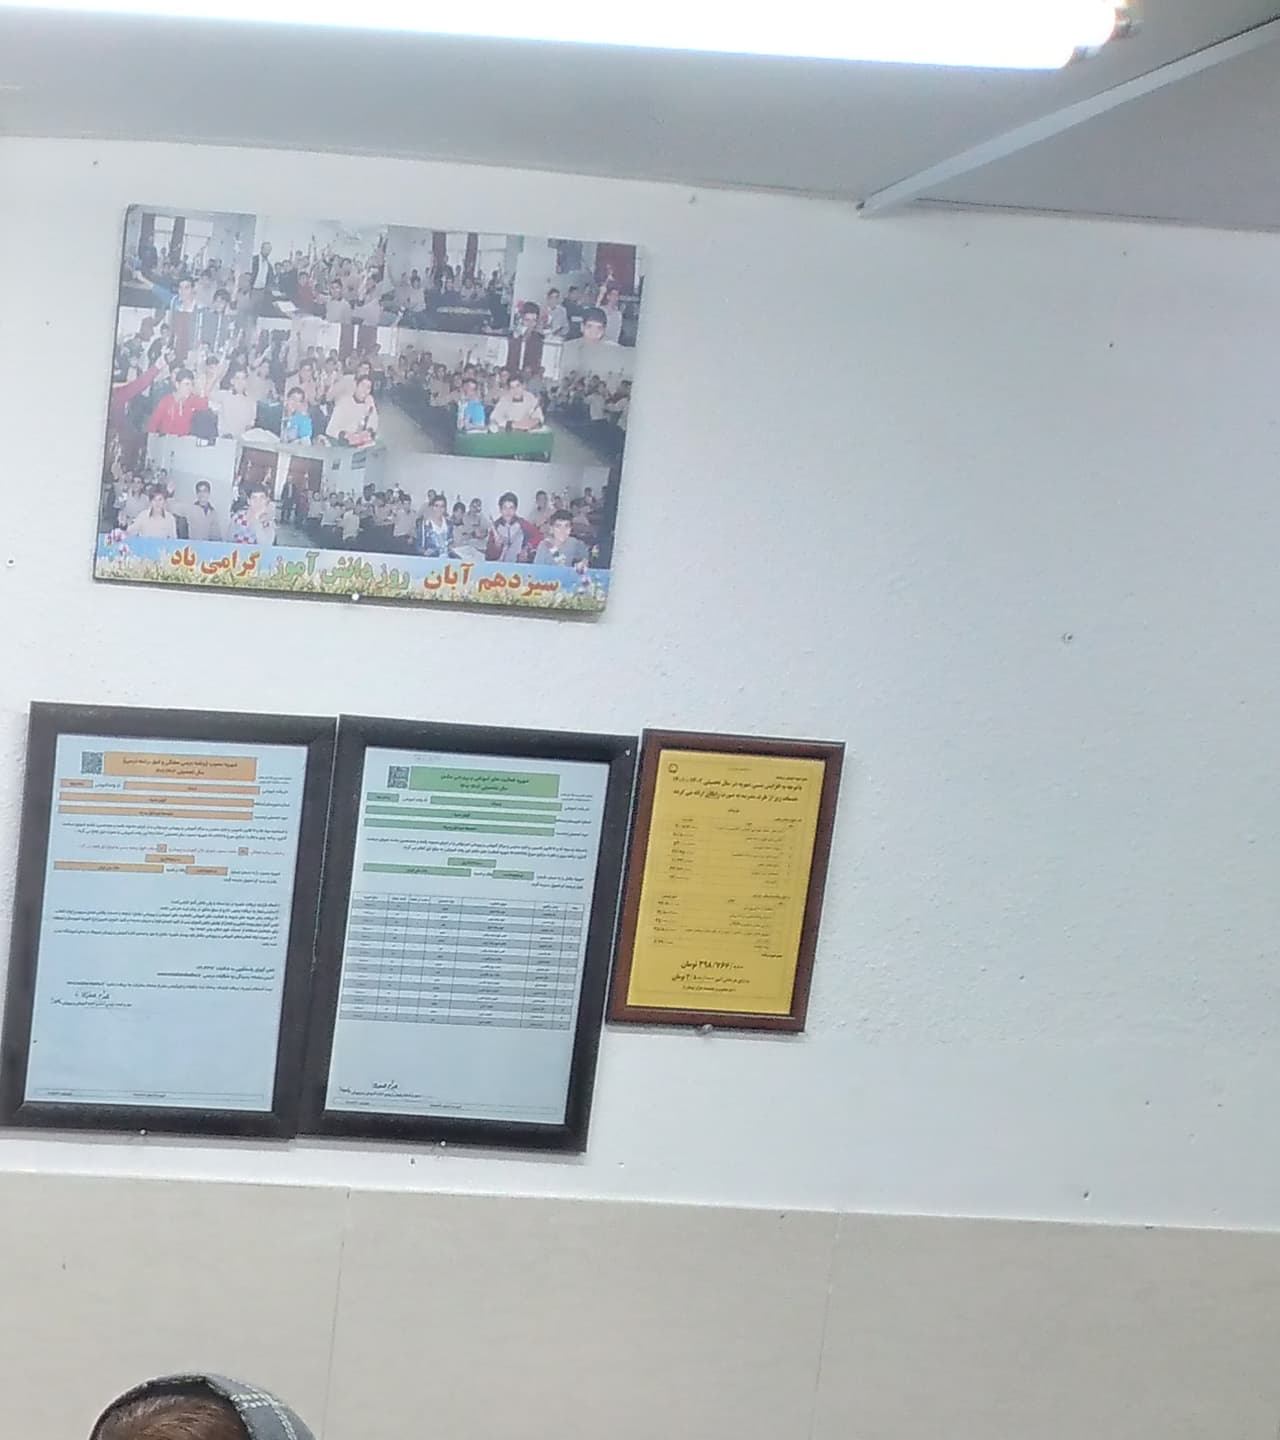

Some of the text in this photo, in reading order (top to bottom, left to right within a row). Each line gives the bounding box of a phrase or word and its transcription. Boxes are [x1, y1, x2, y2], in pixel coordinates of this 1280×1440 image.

[169, 545, 561, 597] سیزدهم آبان روز دانش آموز گرامی باد
